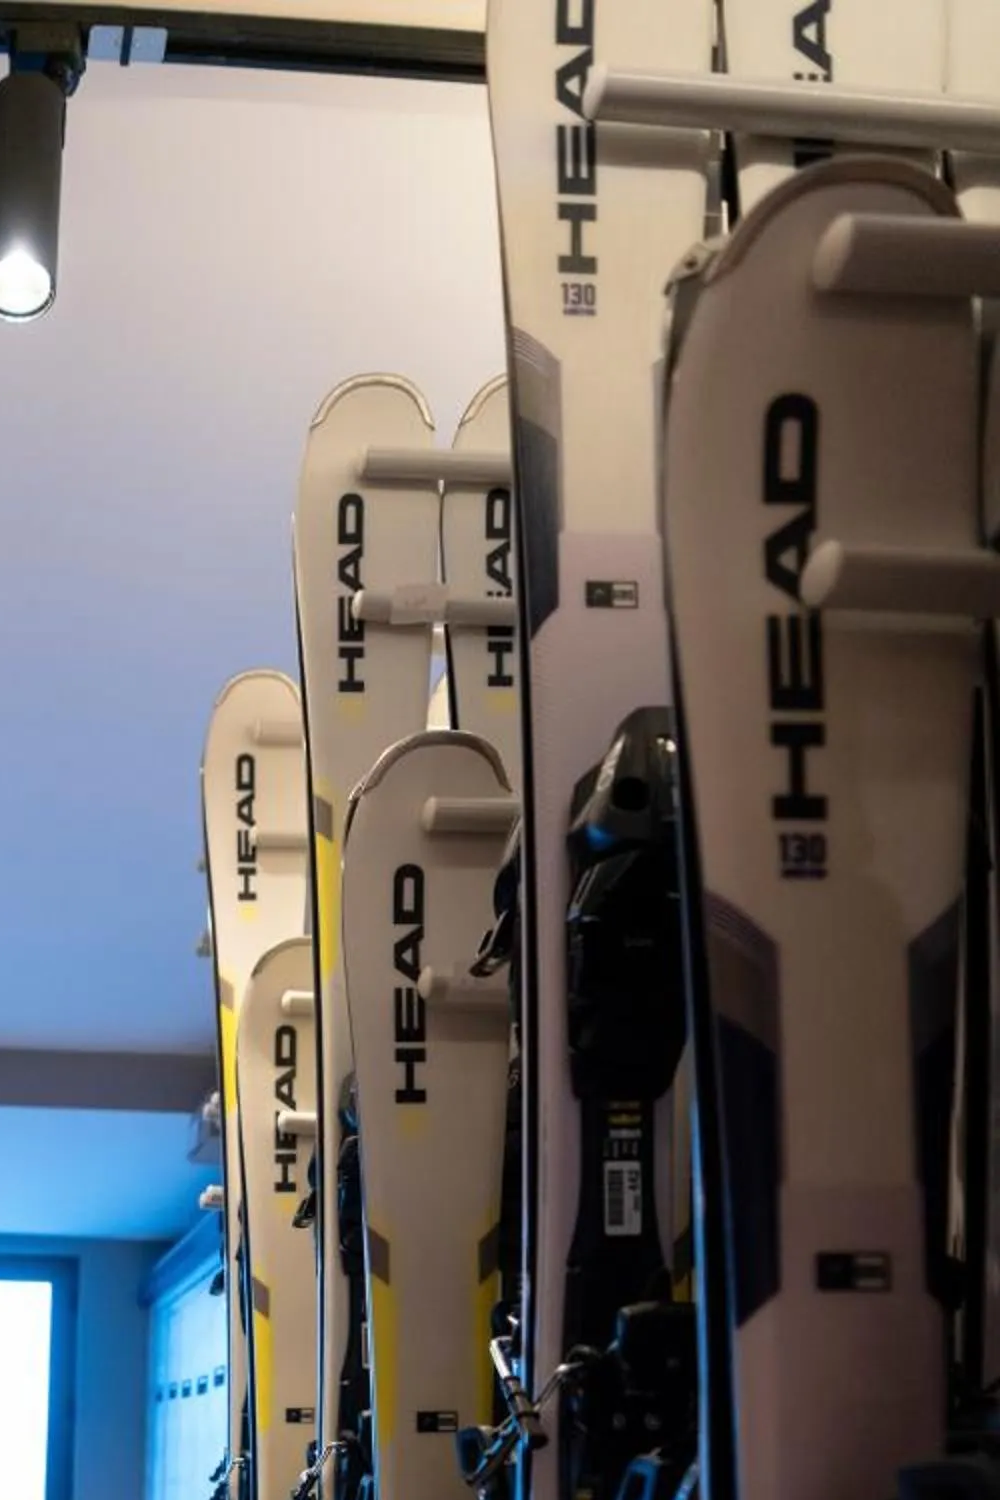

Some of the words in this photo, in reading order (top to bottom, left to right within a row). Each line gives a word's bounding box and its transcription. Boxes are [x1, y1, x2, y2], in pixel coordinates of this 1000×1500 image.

[556, 0, 597, 275] HEAD
[562, 283, 596, 306] 130
[338, 493, 365, 693] HEAD
[763, 393, 828, 820] HEAD
[236, 752, 258, 901] HEAD
[779, 834, 827, 863] 130
[393, 863, 425, 1104] HEAD
[274, 1024, 298, 1193] HEAD
